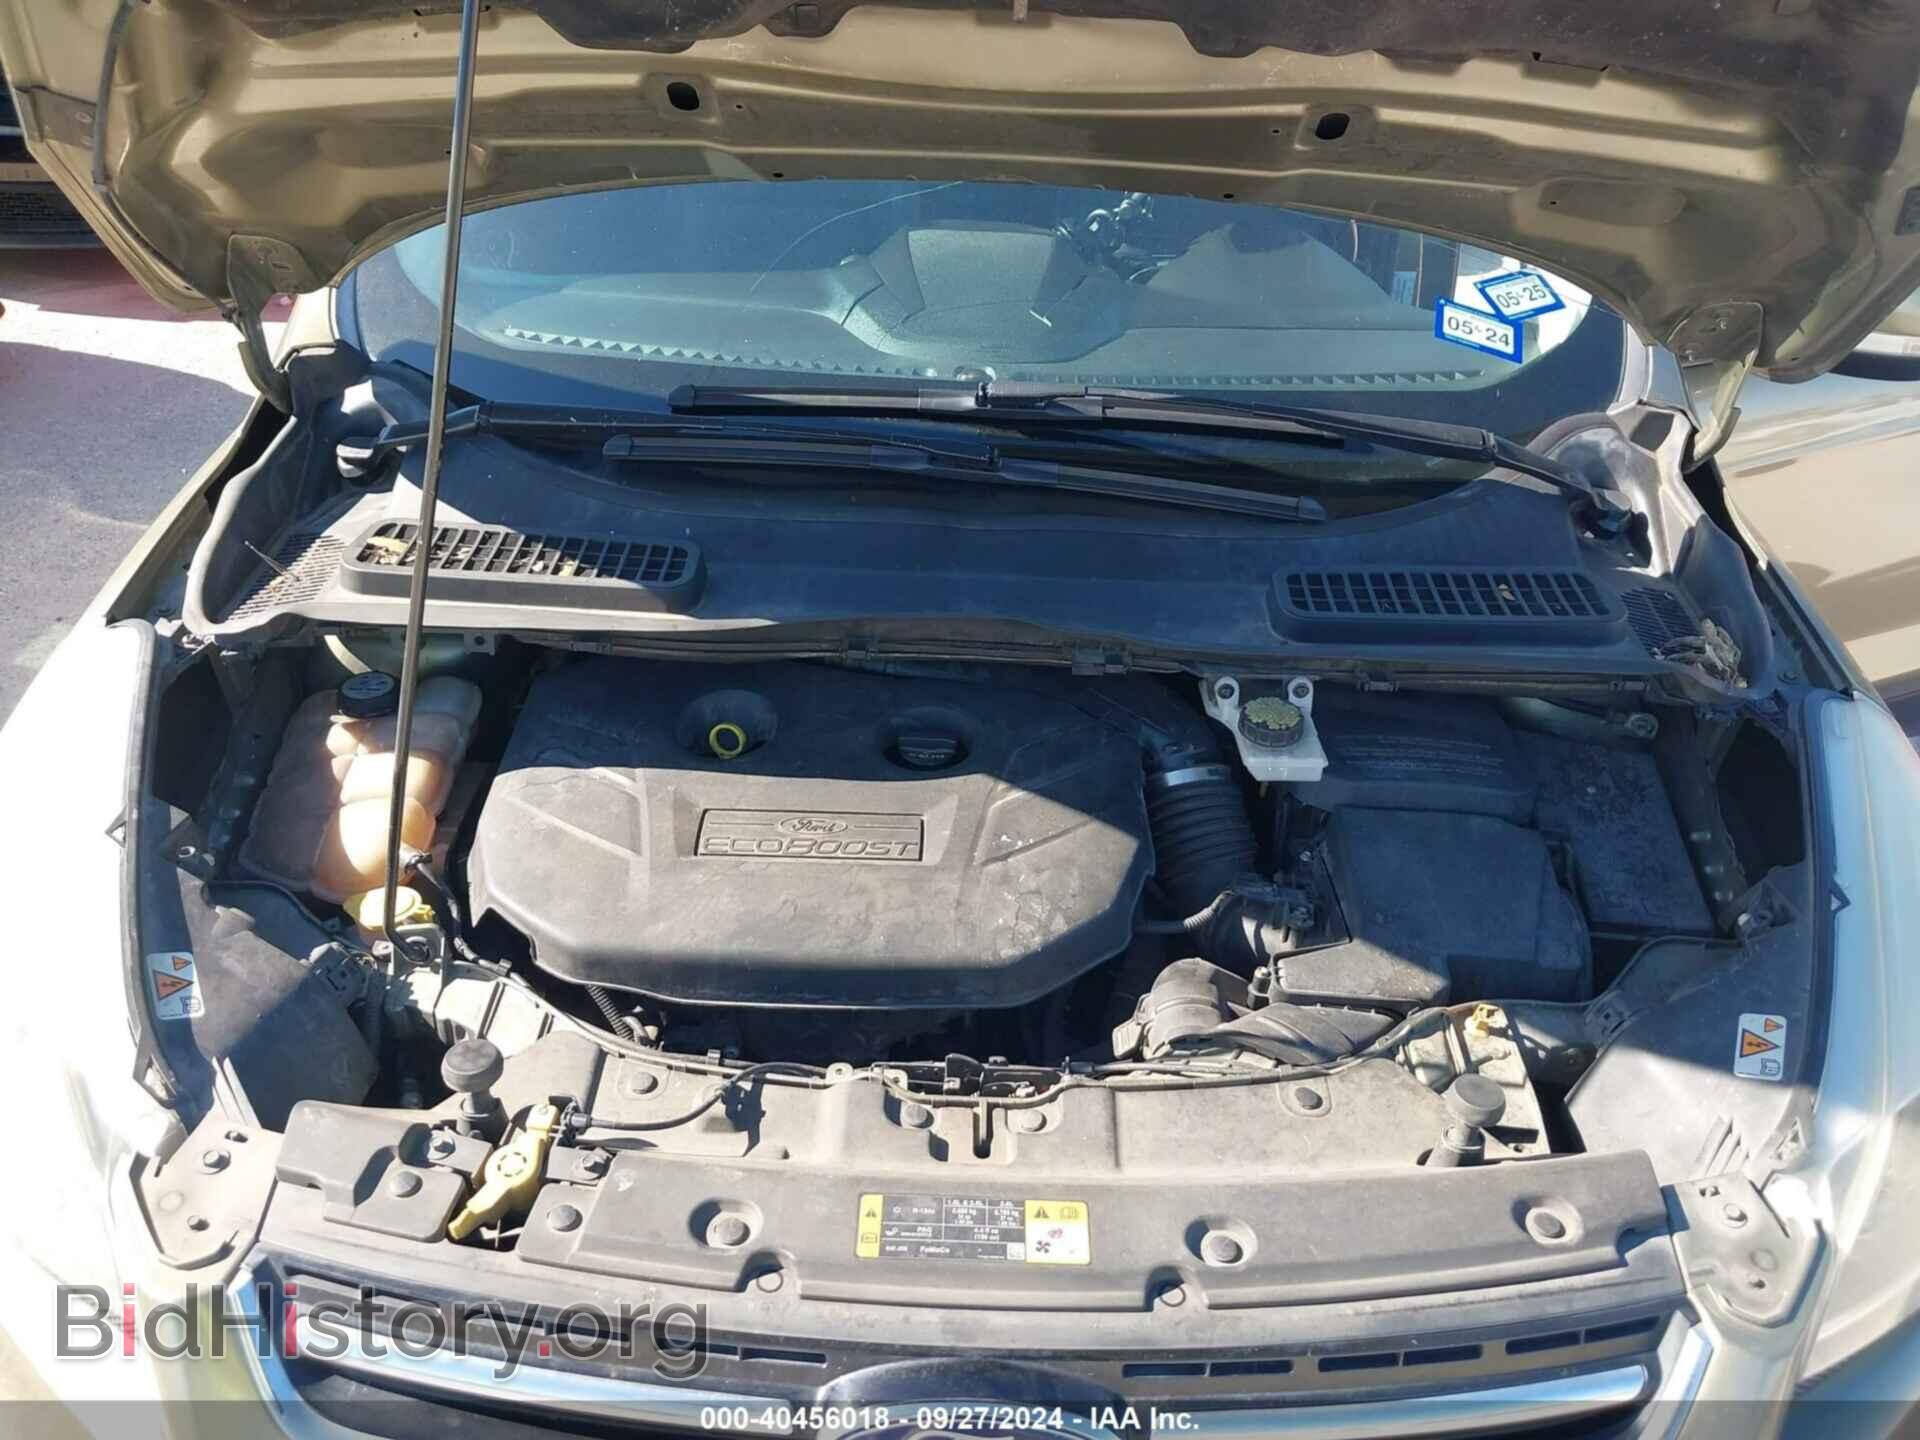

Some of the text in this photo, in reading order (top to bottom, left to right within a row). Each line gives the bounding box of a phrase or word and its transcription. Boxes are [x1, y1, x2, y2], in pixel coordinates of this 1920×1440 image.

[1496, 284, 1547, 308] 05 25
[1447, 316, 1473, 335] 05
[1485, 327, 1510, 347] 24
[792, 817, 836, 833] Ford
[703, 836, 919, 857] ECOBOOST
